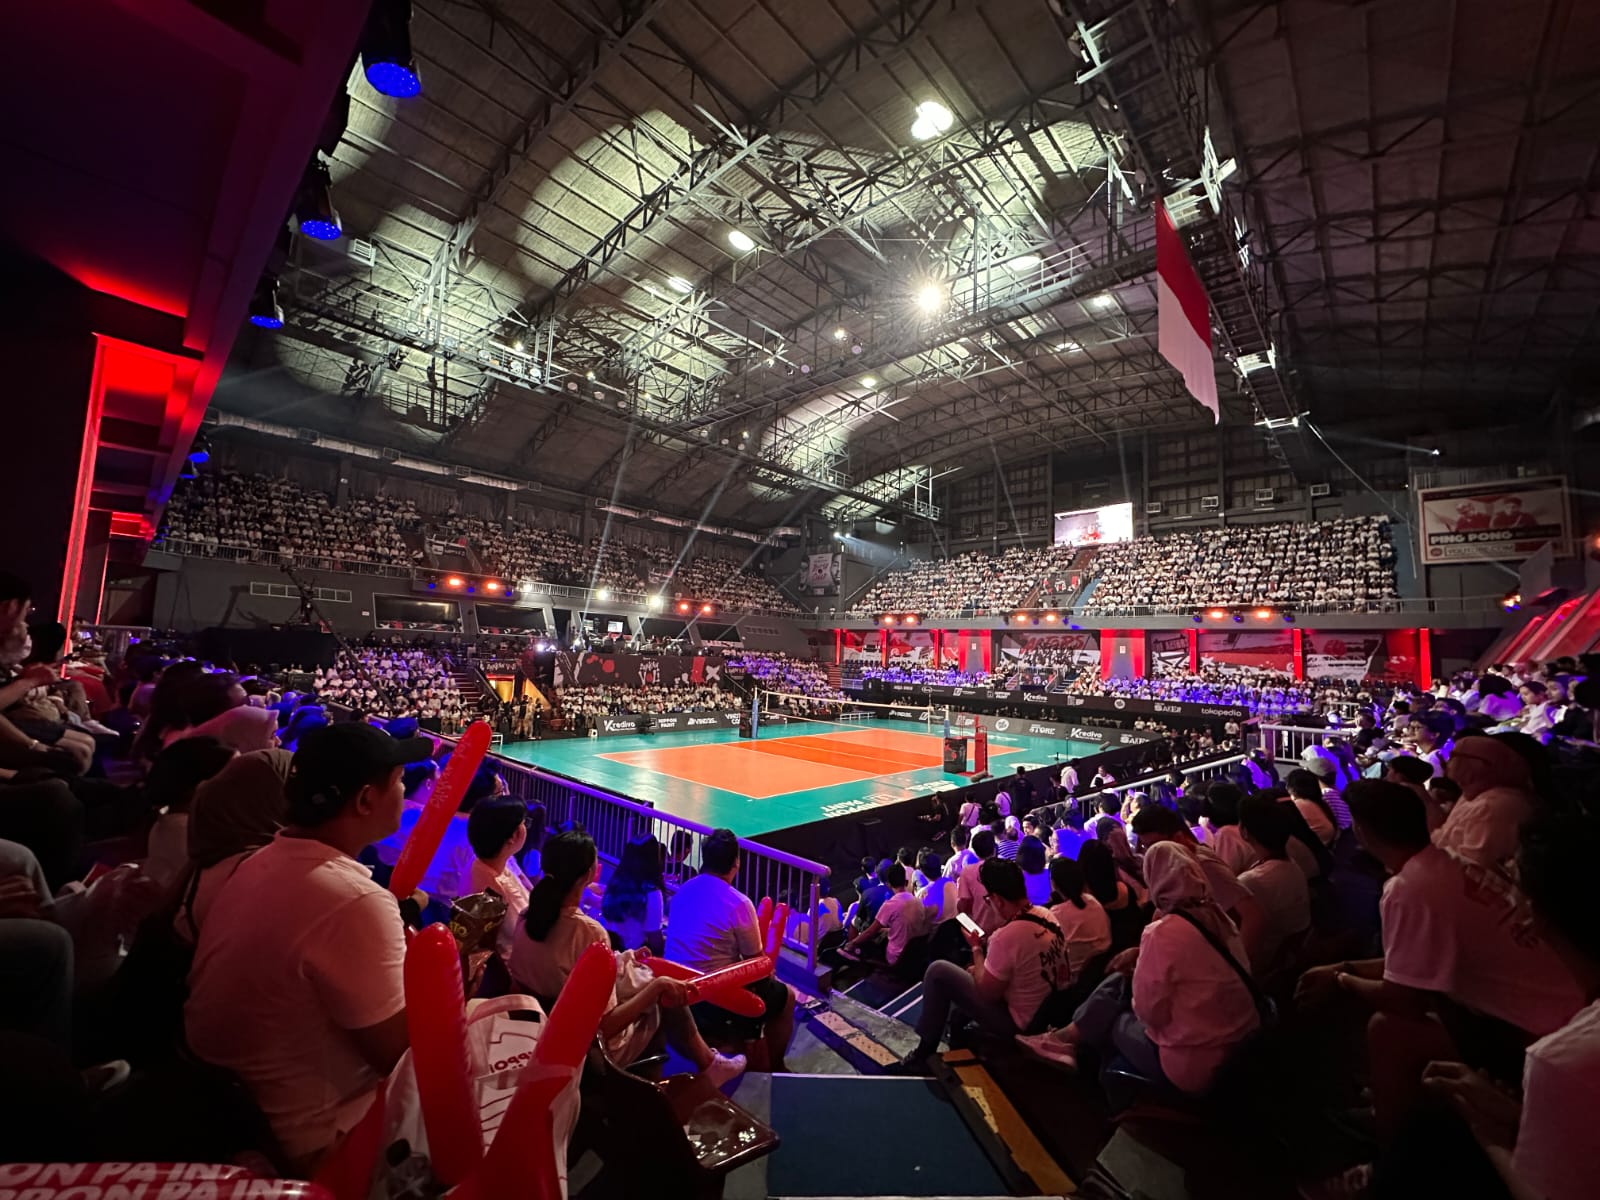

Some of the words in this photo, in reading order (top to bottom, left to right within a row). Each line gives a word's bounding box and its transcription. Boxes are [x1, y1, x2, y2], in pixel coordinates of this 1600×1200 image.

[1430, 534, 1465, 545] PING
[1468, 531, 1513, 543] PONG
[603, 720, 637, 732] Kredivo
[1070, 728, 1103, 740] Kredivo
